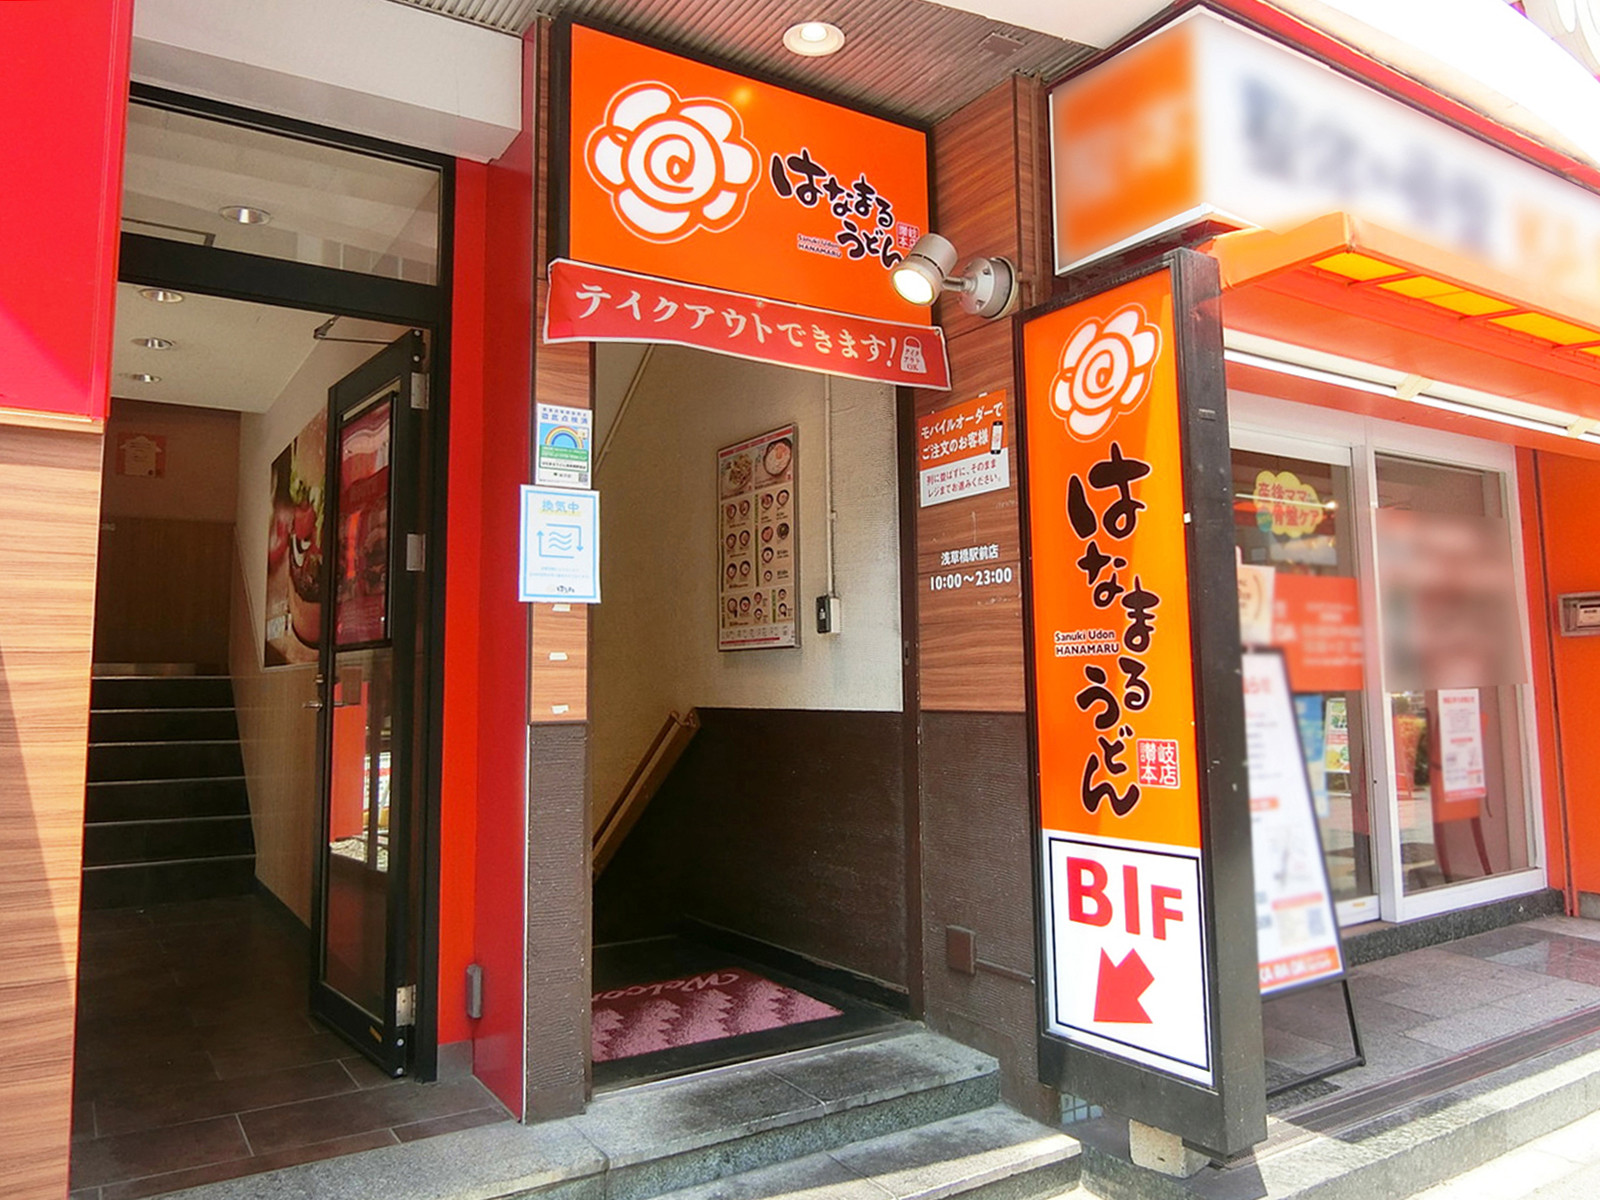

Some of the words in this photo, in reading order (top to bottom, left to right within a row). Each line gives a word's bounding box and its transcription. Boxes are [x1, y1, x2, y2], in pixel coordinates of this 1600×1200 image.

[769, 147, 894, 228] はなまる
[837, 219, 904, 269] うどん
[575, 283, 896, 366] テイクアウトできます!
[921, 402, 1004, 439] モバイルオーダーで
[922, 428, 989, 460] ご注文のお客様
[542, 500, 580, 513] 換気中
[940, 544, 999, 566] 浅草橋駅前店
[1055, 630, 1086, 641] Sanuki
[1088, 630, 1115, 641] Udon
[1055, 643, 1120, 656] HANAMARU
